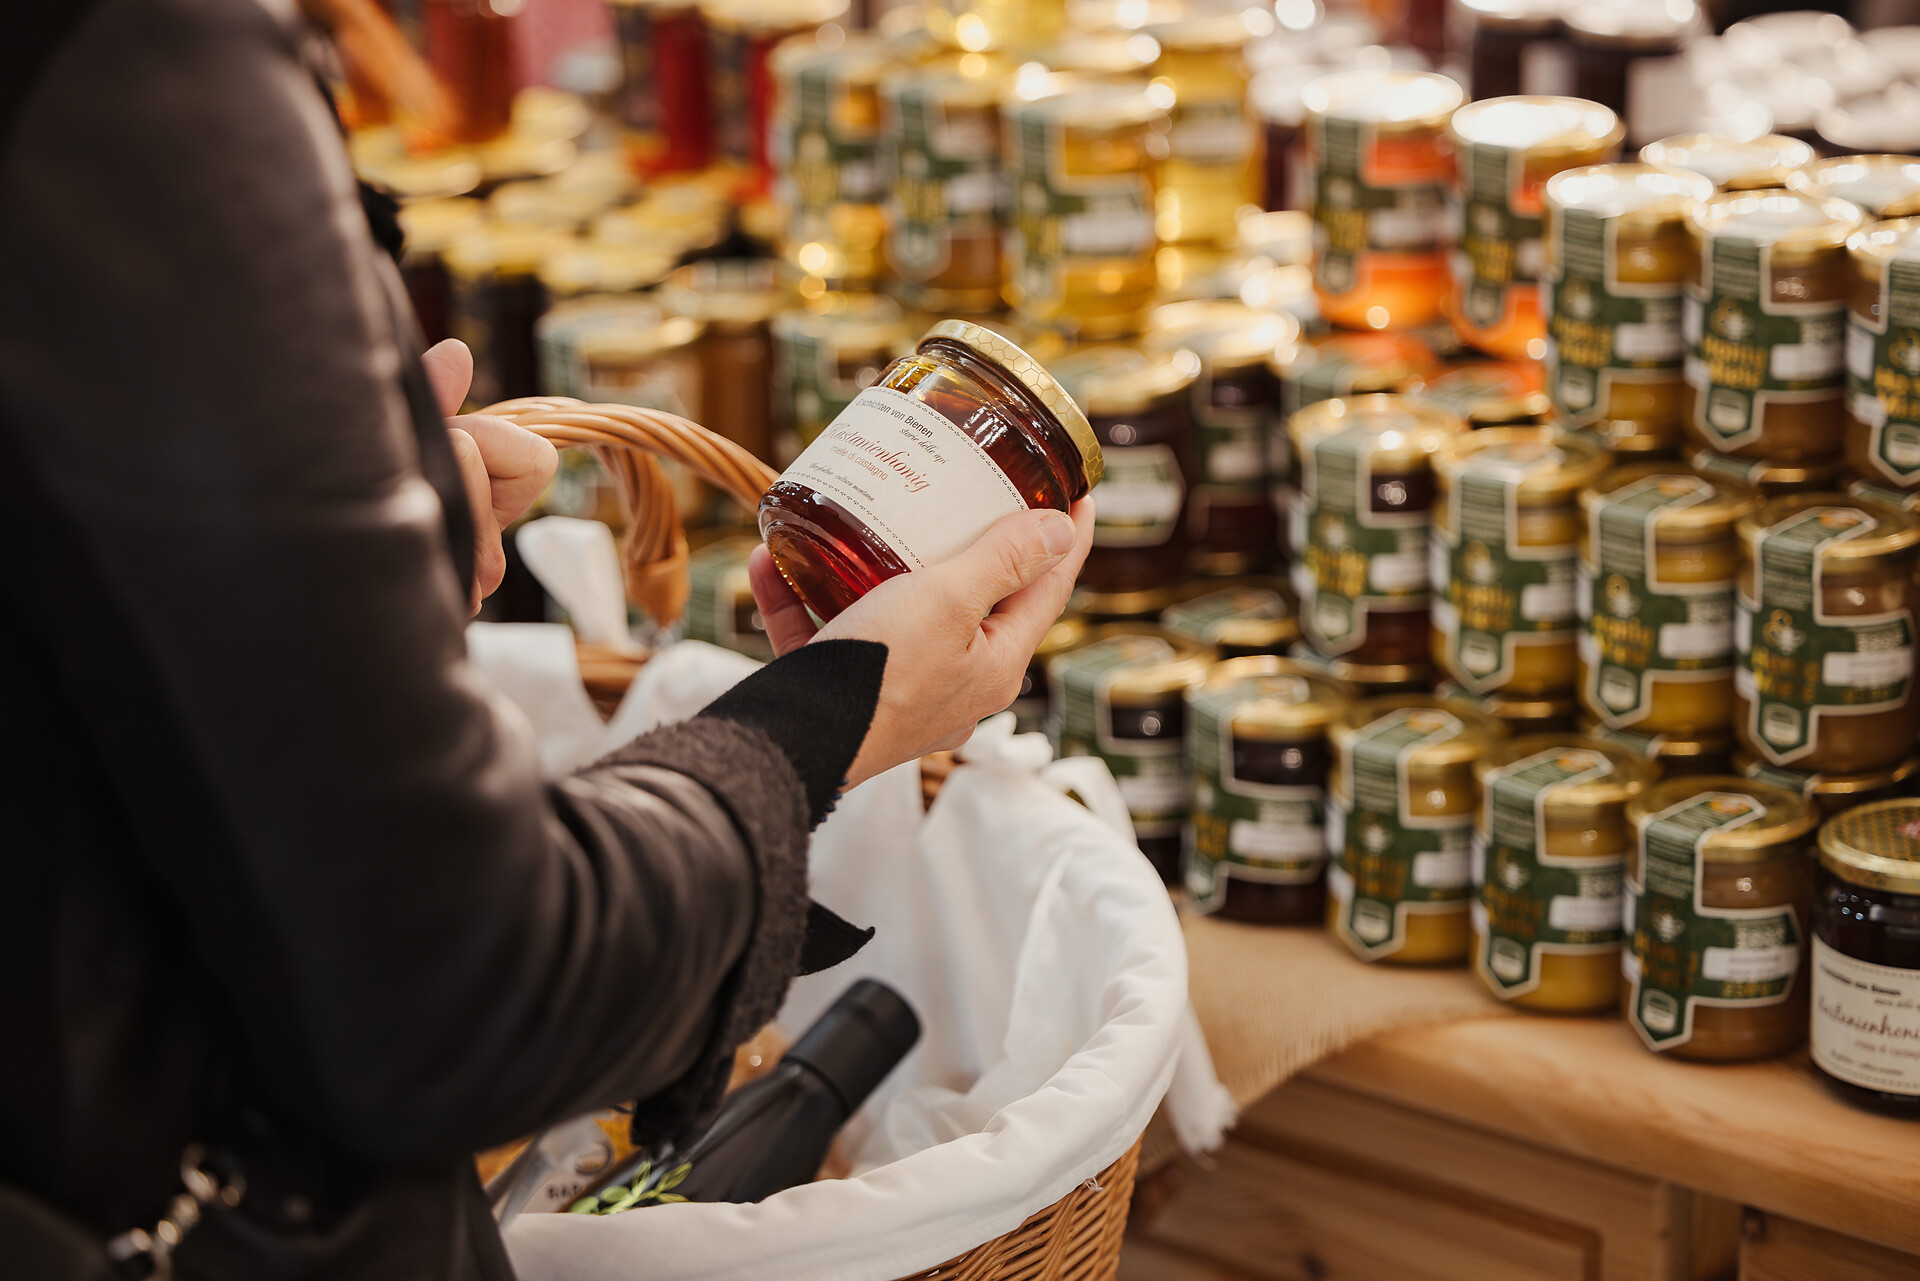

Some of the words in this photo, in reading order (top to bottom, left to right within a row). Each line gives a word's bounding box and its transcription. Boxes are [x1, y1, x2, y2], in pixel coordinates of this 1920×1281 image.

[890, 407, 906, 421] von
[905, 415, 934, 439] Bienen
[822, 421, 931, 493] Kastanienhonig
[899, 428, 919, 443] storie
[917, 440, 938, 456] delle
[934, 453, 949, 465] api
[847, 452, 855, 460] di
[854, 456, 889, 481] castagno
